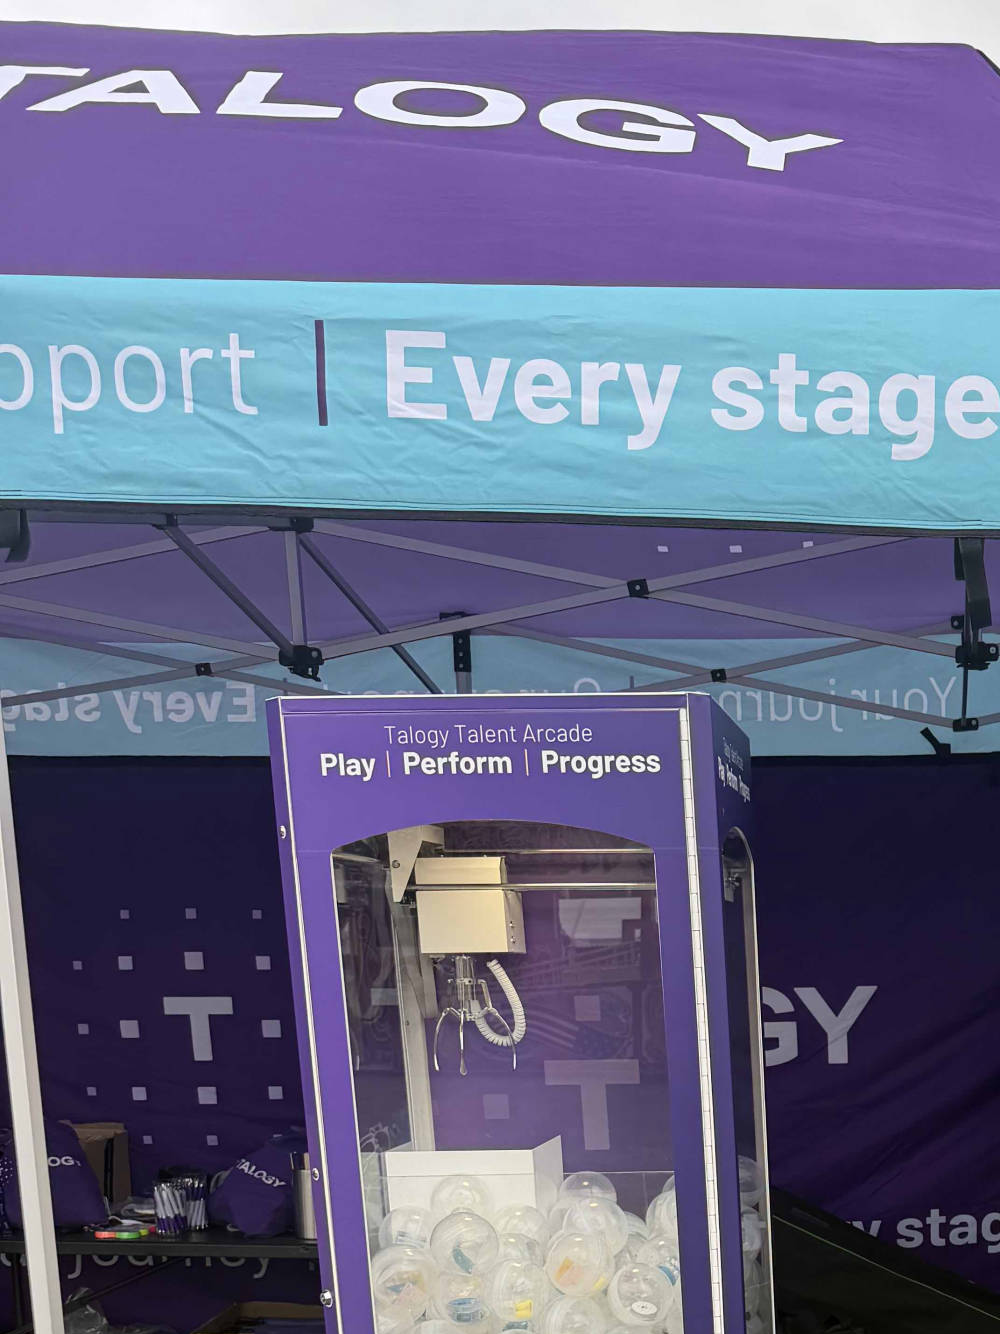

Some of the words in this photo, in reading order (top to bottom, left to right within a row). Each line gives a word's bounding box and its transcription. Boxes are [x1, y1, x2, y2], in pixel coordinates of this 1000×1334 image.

[386, 329, 682, 450] Every
[711, 352, 1000, 461] stage
[384, 725, 449, 748] Talogy
[454, 724, 517, 743] Talent
[523, 723, 593, 743] Arcade
[320, 753, 376, 781] Play
[403, 751, 512, 775] Perform
[541, 749, 661, 779] Progress
